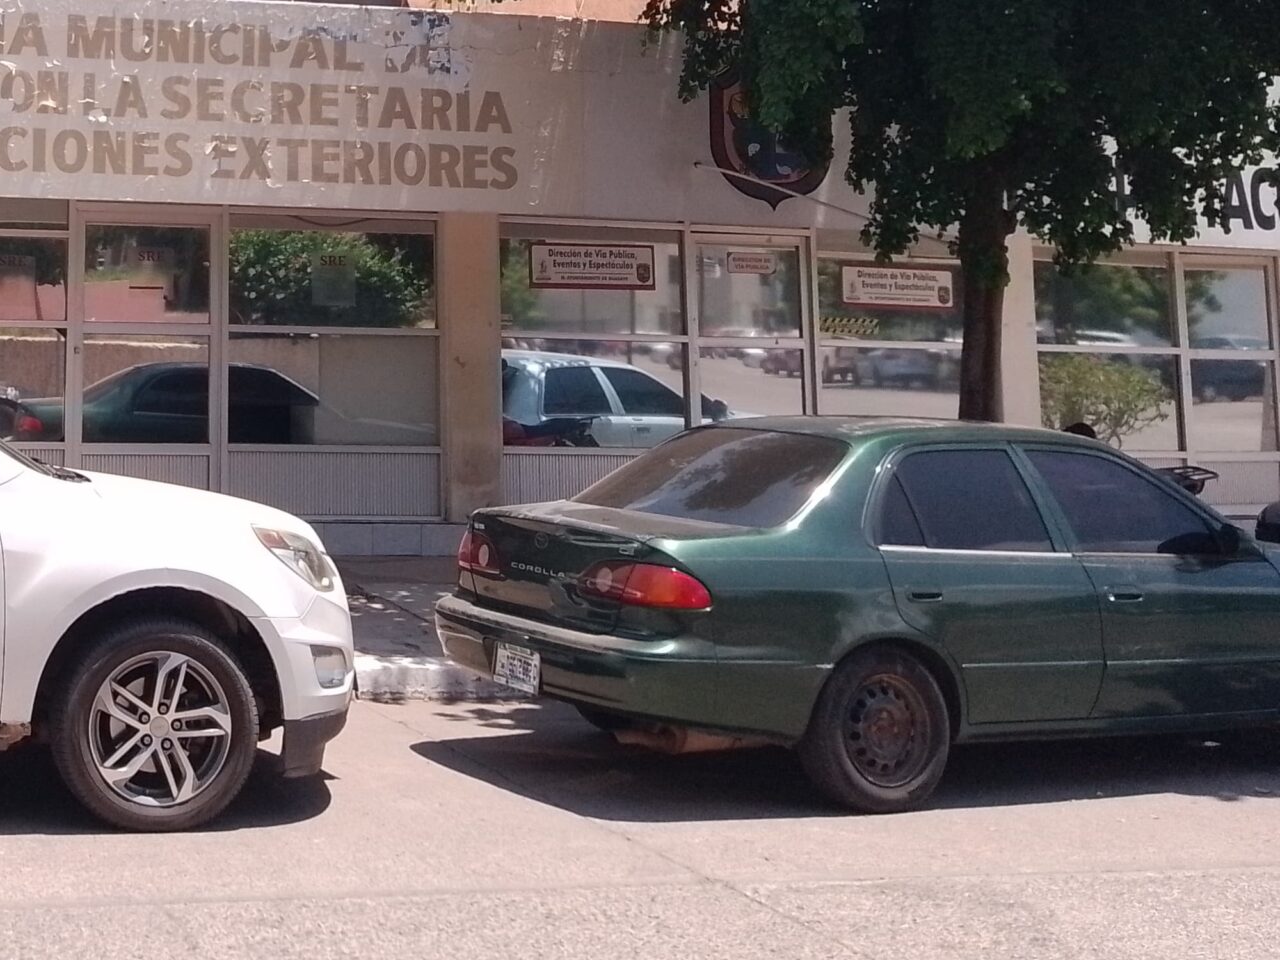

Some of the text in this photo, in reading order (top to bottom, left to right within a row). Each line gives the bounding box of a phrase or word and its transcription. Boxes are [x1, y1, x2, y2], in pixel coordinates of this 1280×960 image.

[67, 14, 365, 72] MUNICIPAL
[82, 72, 149, 119] LA
[160, 75, 513, 134] SECRETARIA
[210, 135, 519, 190] EXTERIORES
[584, 250, 592, 258] de
[0, 256, 26, 267] SRE
[320, 255, 347, 266] SRE
[553, 260, 580, 269] Eventos
[582, 262, 587, 270] y
[890, 271, 898, 280] de
[862, 280, 888, 290] Eventos
[888, 283, 893, 292] y
[510, 561, 566, 578] COROLLA
